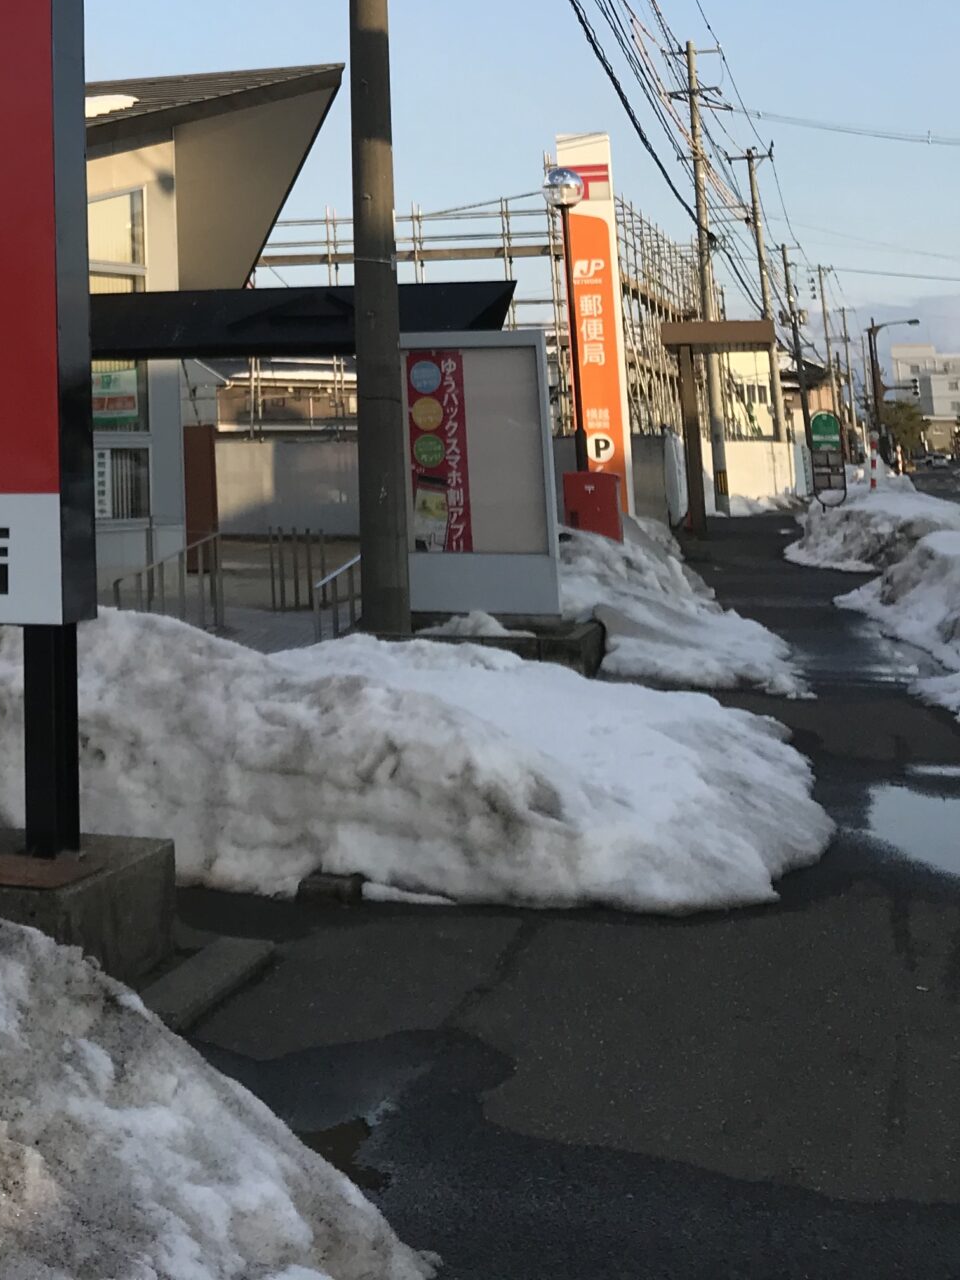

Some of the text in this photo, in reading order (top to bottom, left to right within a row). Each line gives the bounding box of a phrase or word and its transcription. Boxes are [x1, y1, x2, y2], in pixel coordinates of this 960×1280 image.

[579, 293, 606, 366] 郵便局
[594, 438, 611, 459] P
